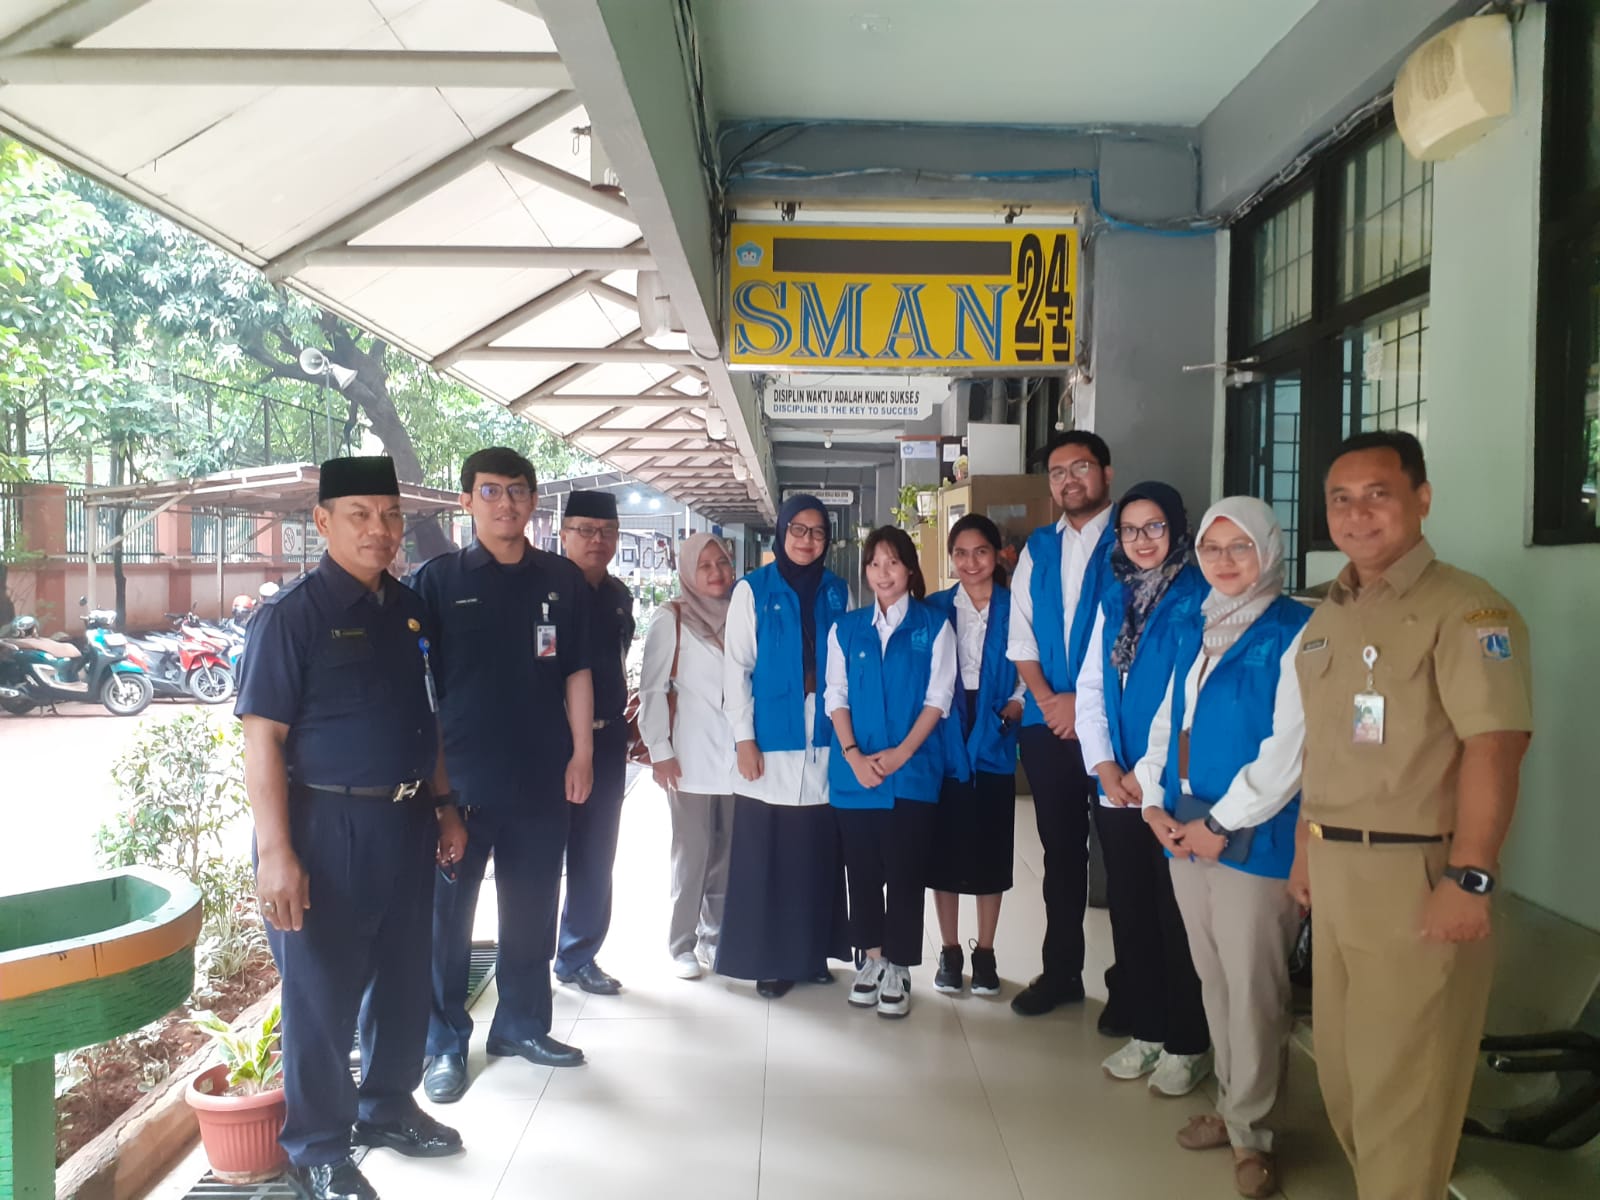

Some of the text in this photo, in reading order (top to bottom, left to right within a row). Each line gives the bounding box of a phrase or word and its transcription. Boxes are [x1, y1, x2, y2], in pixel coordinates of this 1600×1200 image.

[732, 280, 1012, 361] SMAN
[1015, 233, 1073, 362] 24
[773, 389, 920, 404] DISIPLIN WAKTU ADALAH KUNCI SUKSES
[773, 404, 918, 416] DISCIPLINE IS THE KEY TO SUCCESS
